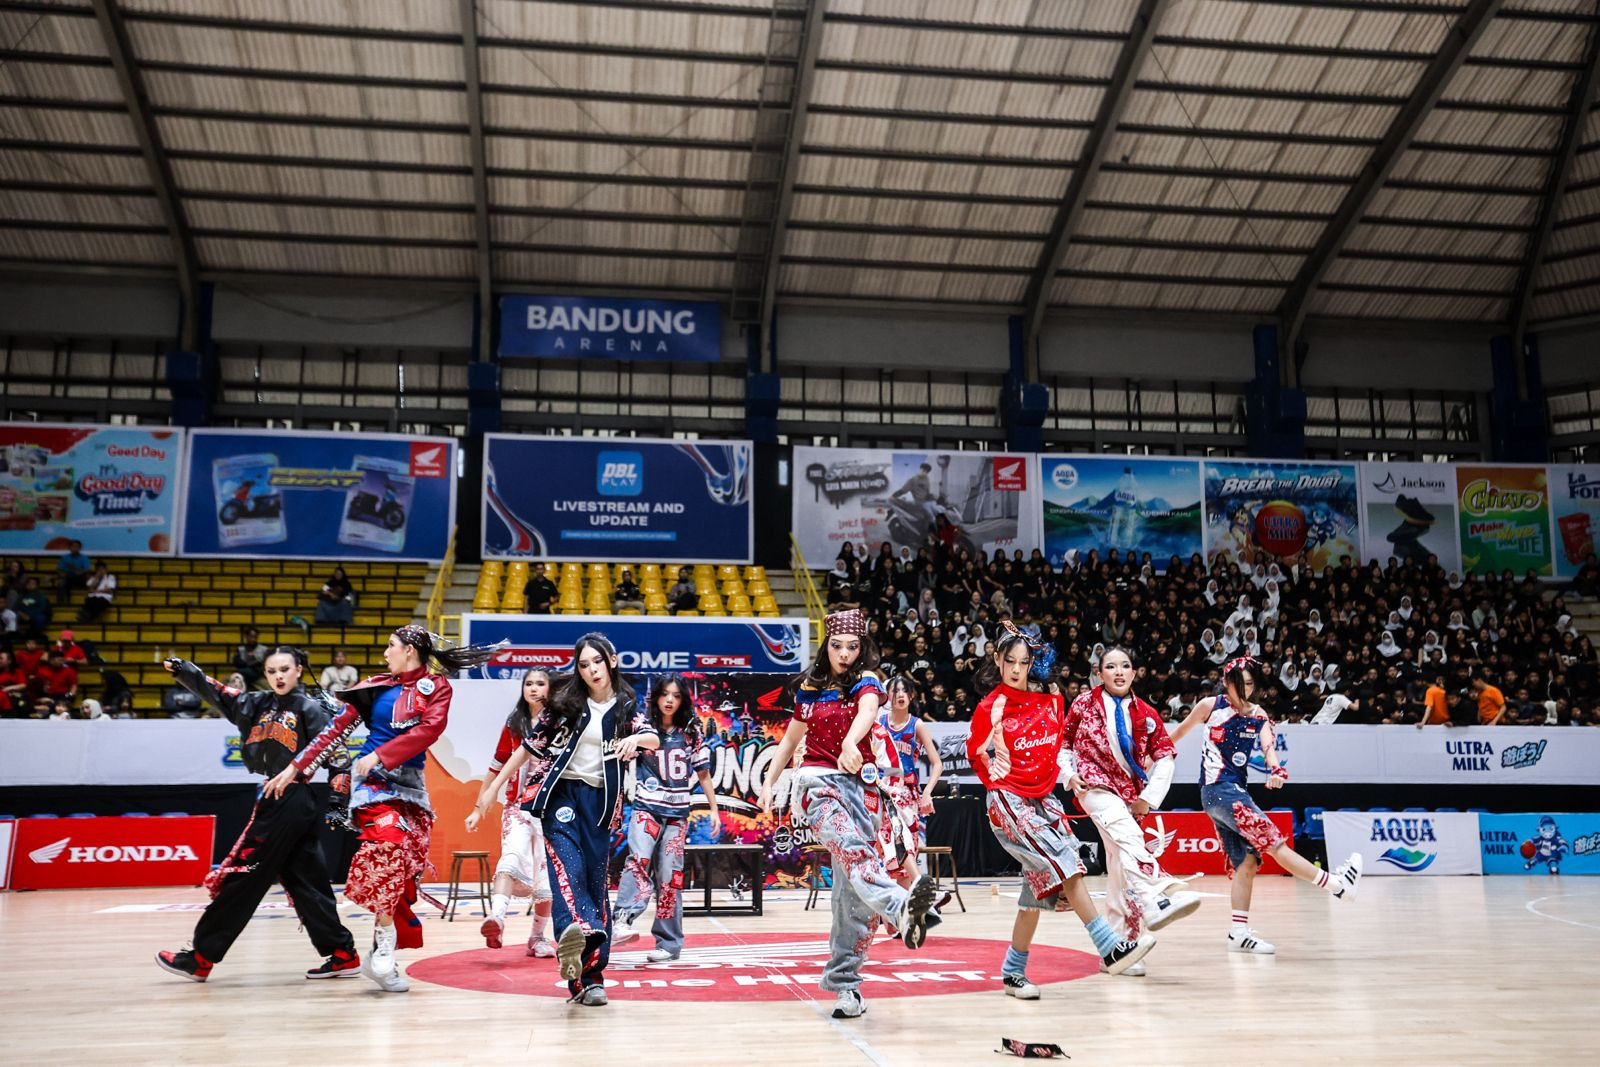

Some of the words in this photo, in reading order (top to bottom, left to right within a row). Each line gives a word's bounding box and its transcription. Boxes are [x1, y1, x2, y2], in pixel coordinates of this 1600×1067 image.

[526, 304, 696, 335] BANDUNG
[107, 444, 139, 457] Good
[141, 445, 165, 461] Day
[602, 463, 638, 479] DBL
[1568, 472, 1586, 485] La
[81, 474, 129, 494] Good
[130, 471, 165, 495] Day
[601, 478, 636, 487] PLAY
[1220, 479, 1275, 496] BREAK
[1278, 480, 1293, 488] THE
[1294, 475, 1341, 491] DOUBT
[1400, 475, 1445, 489] Jackson
[96, 490, 145, 510] Time!
[553, 501, 650, 513] LIVESTREAM
[653, 503, 685, 513] AND
[589, 515, 648, 527] UPDATE
[512, 655, 562, 663] HONDA
[615, 652, 690, 668] OME
[701, 657, 717, 665] OF
[720, 657, 745, 665] THE
[1013, 730, 1058, 751] Bandung
[1446, 741, 1494, 755] ULTRA
[655, 749, 688, 781] 16
[1453, 757, 1490, 771] MILK
[1371, 818, 1437, 847] AQUA
[1480, 831, 1518, 842] ULTRA
[68, 845, 198, 863] HONDA
[1484, 844, 1515, 855] MILK
